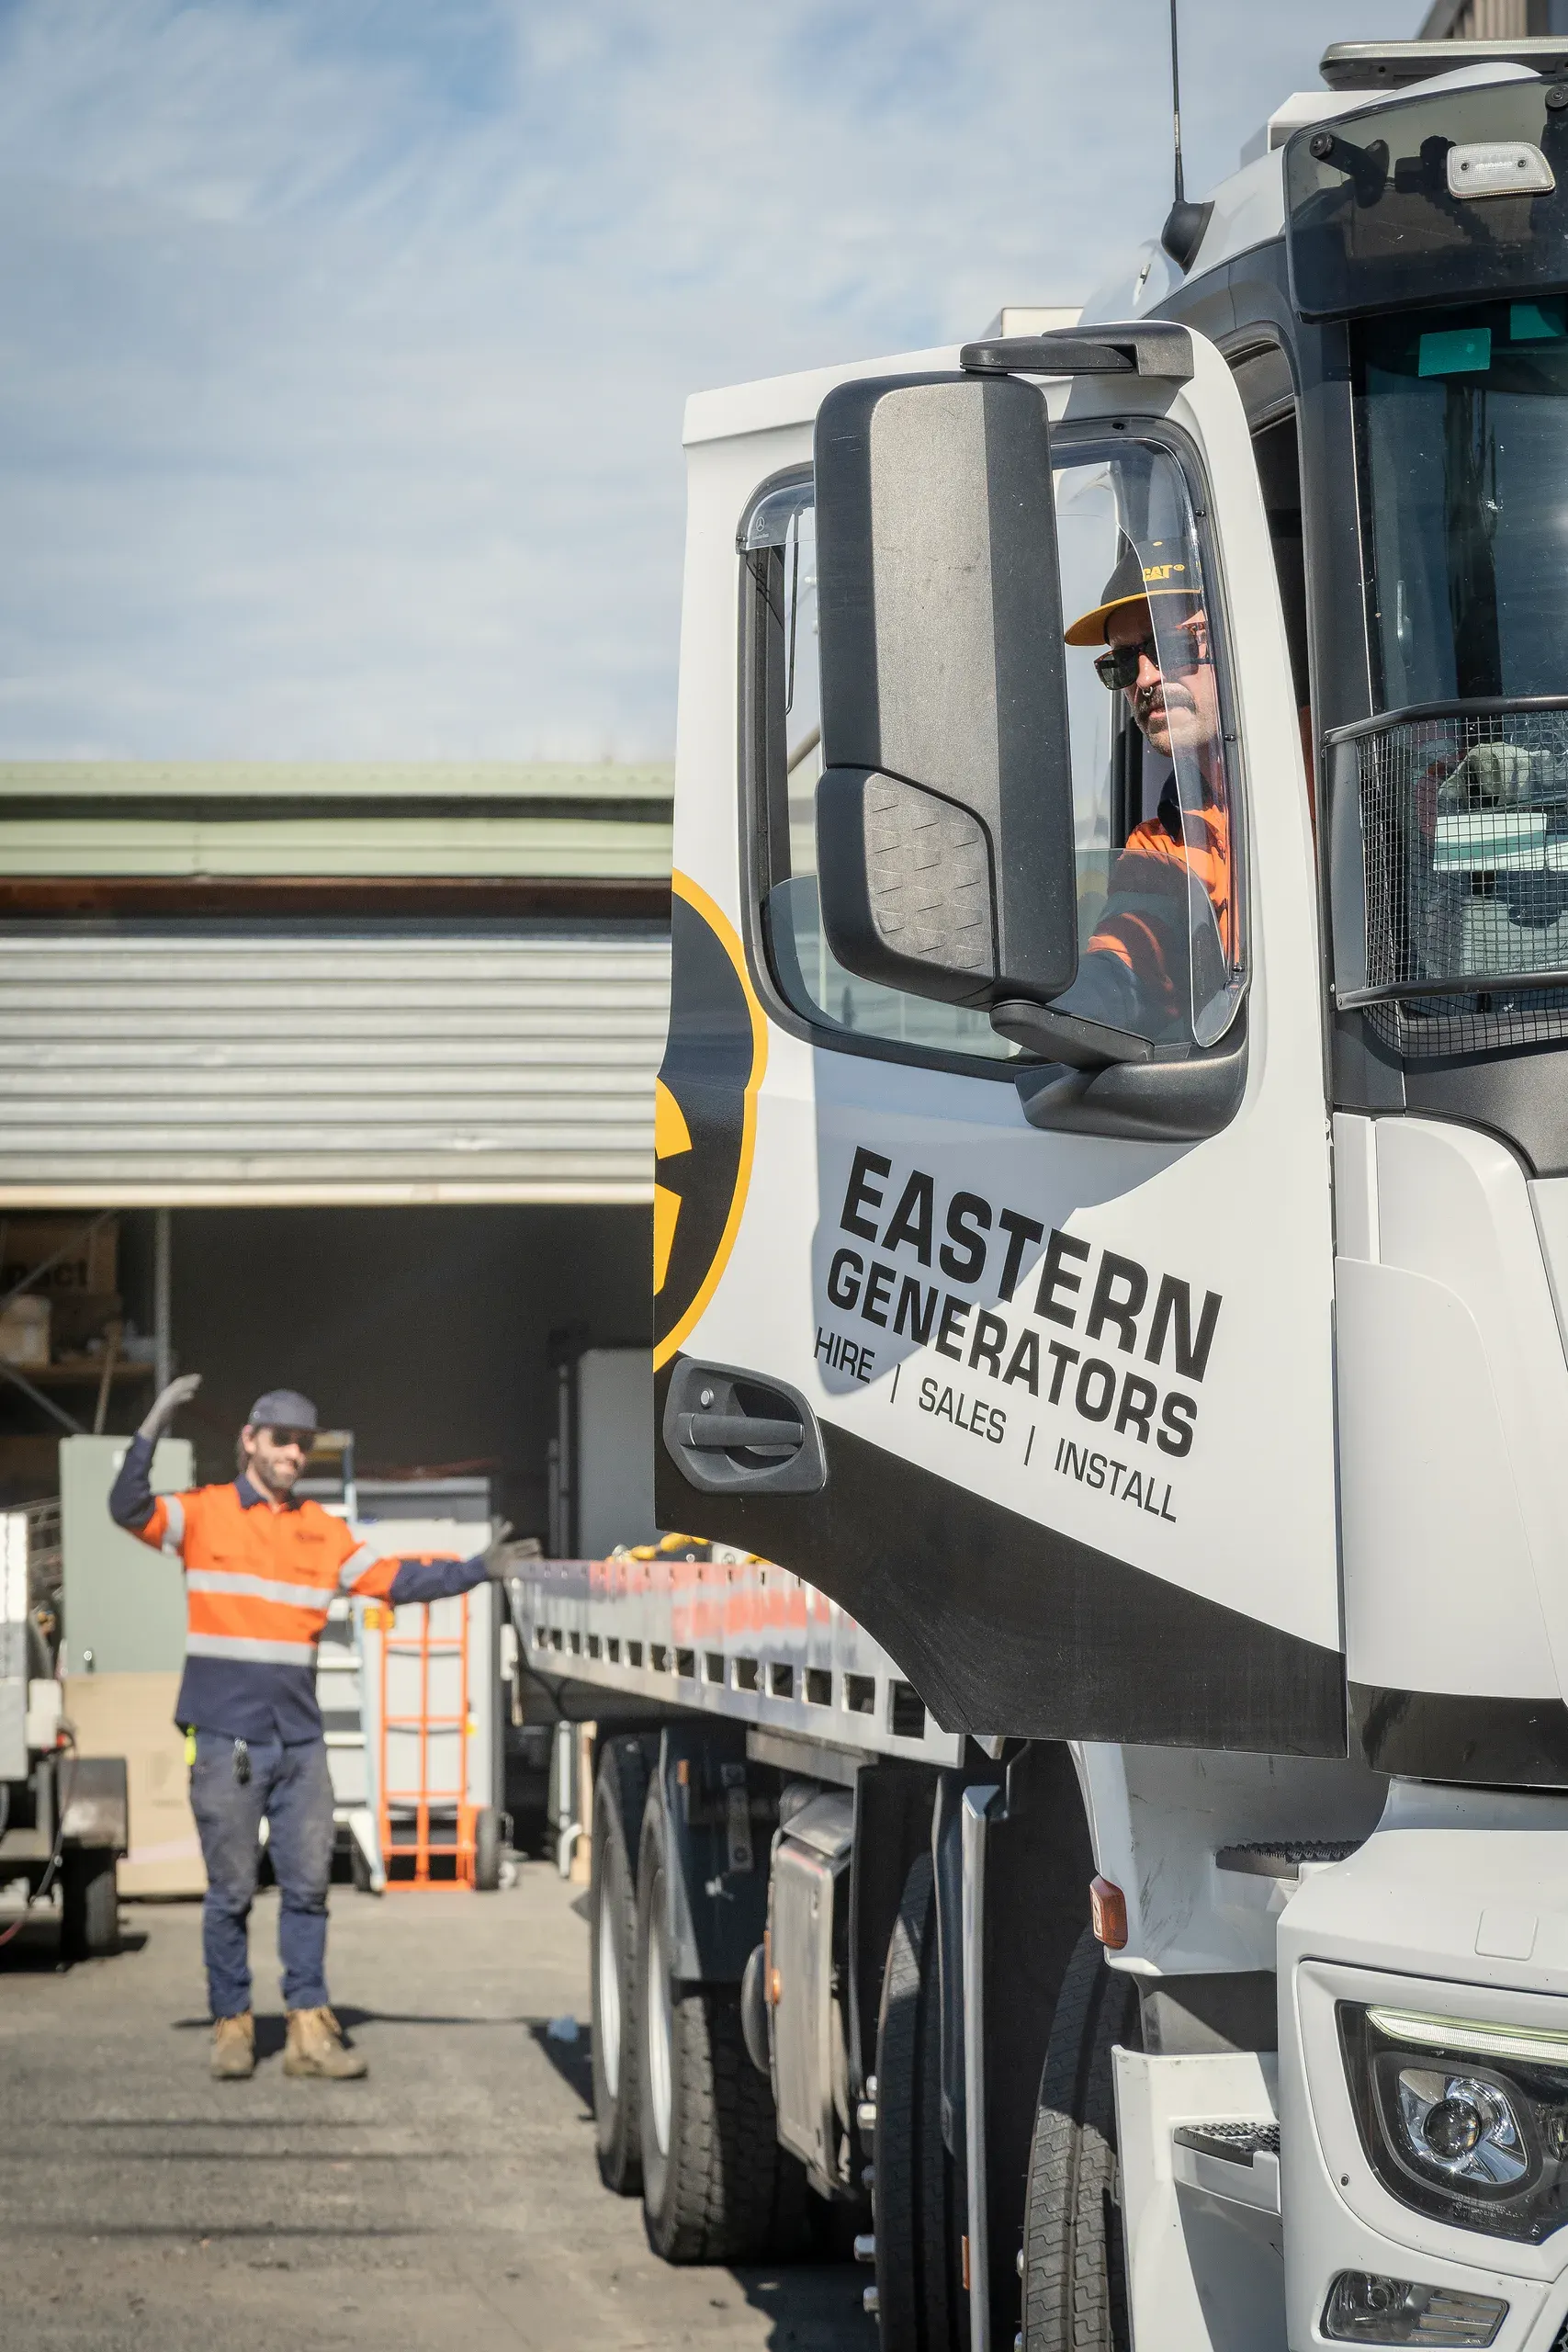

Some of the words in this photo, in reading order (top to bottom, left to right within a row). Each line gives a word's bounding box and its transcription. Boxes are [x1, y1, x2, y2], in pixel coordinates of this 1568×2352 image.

[827, 1248, 1198, 1458] GENERATORS
[839, 1145, 1223, 1383] EASTERN
[813, 1326, 875, 1385] HIRE
[919, 1377, 1007, 1444] SALES
[1054, 1438, 1177, 1523] INSTALL
